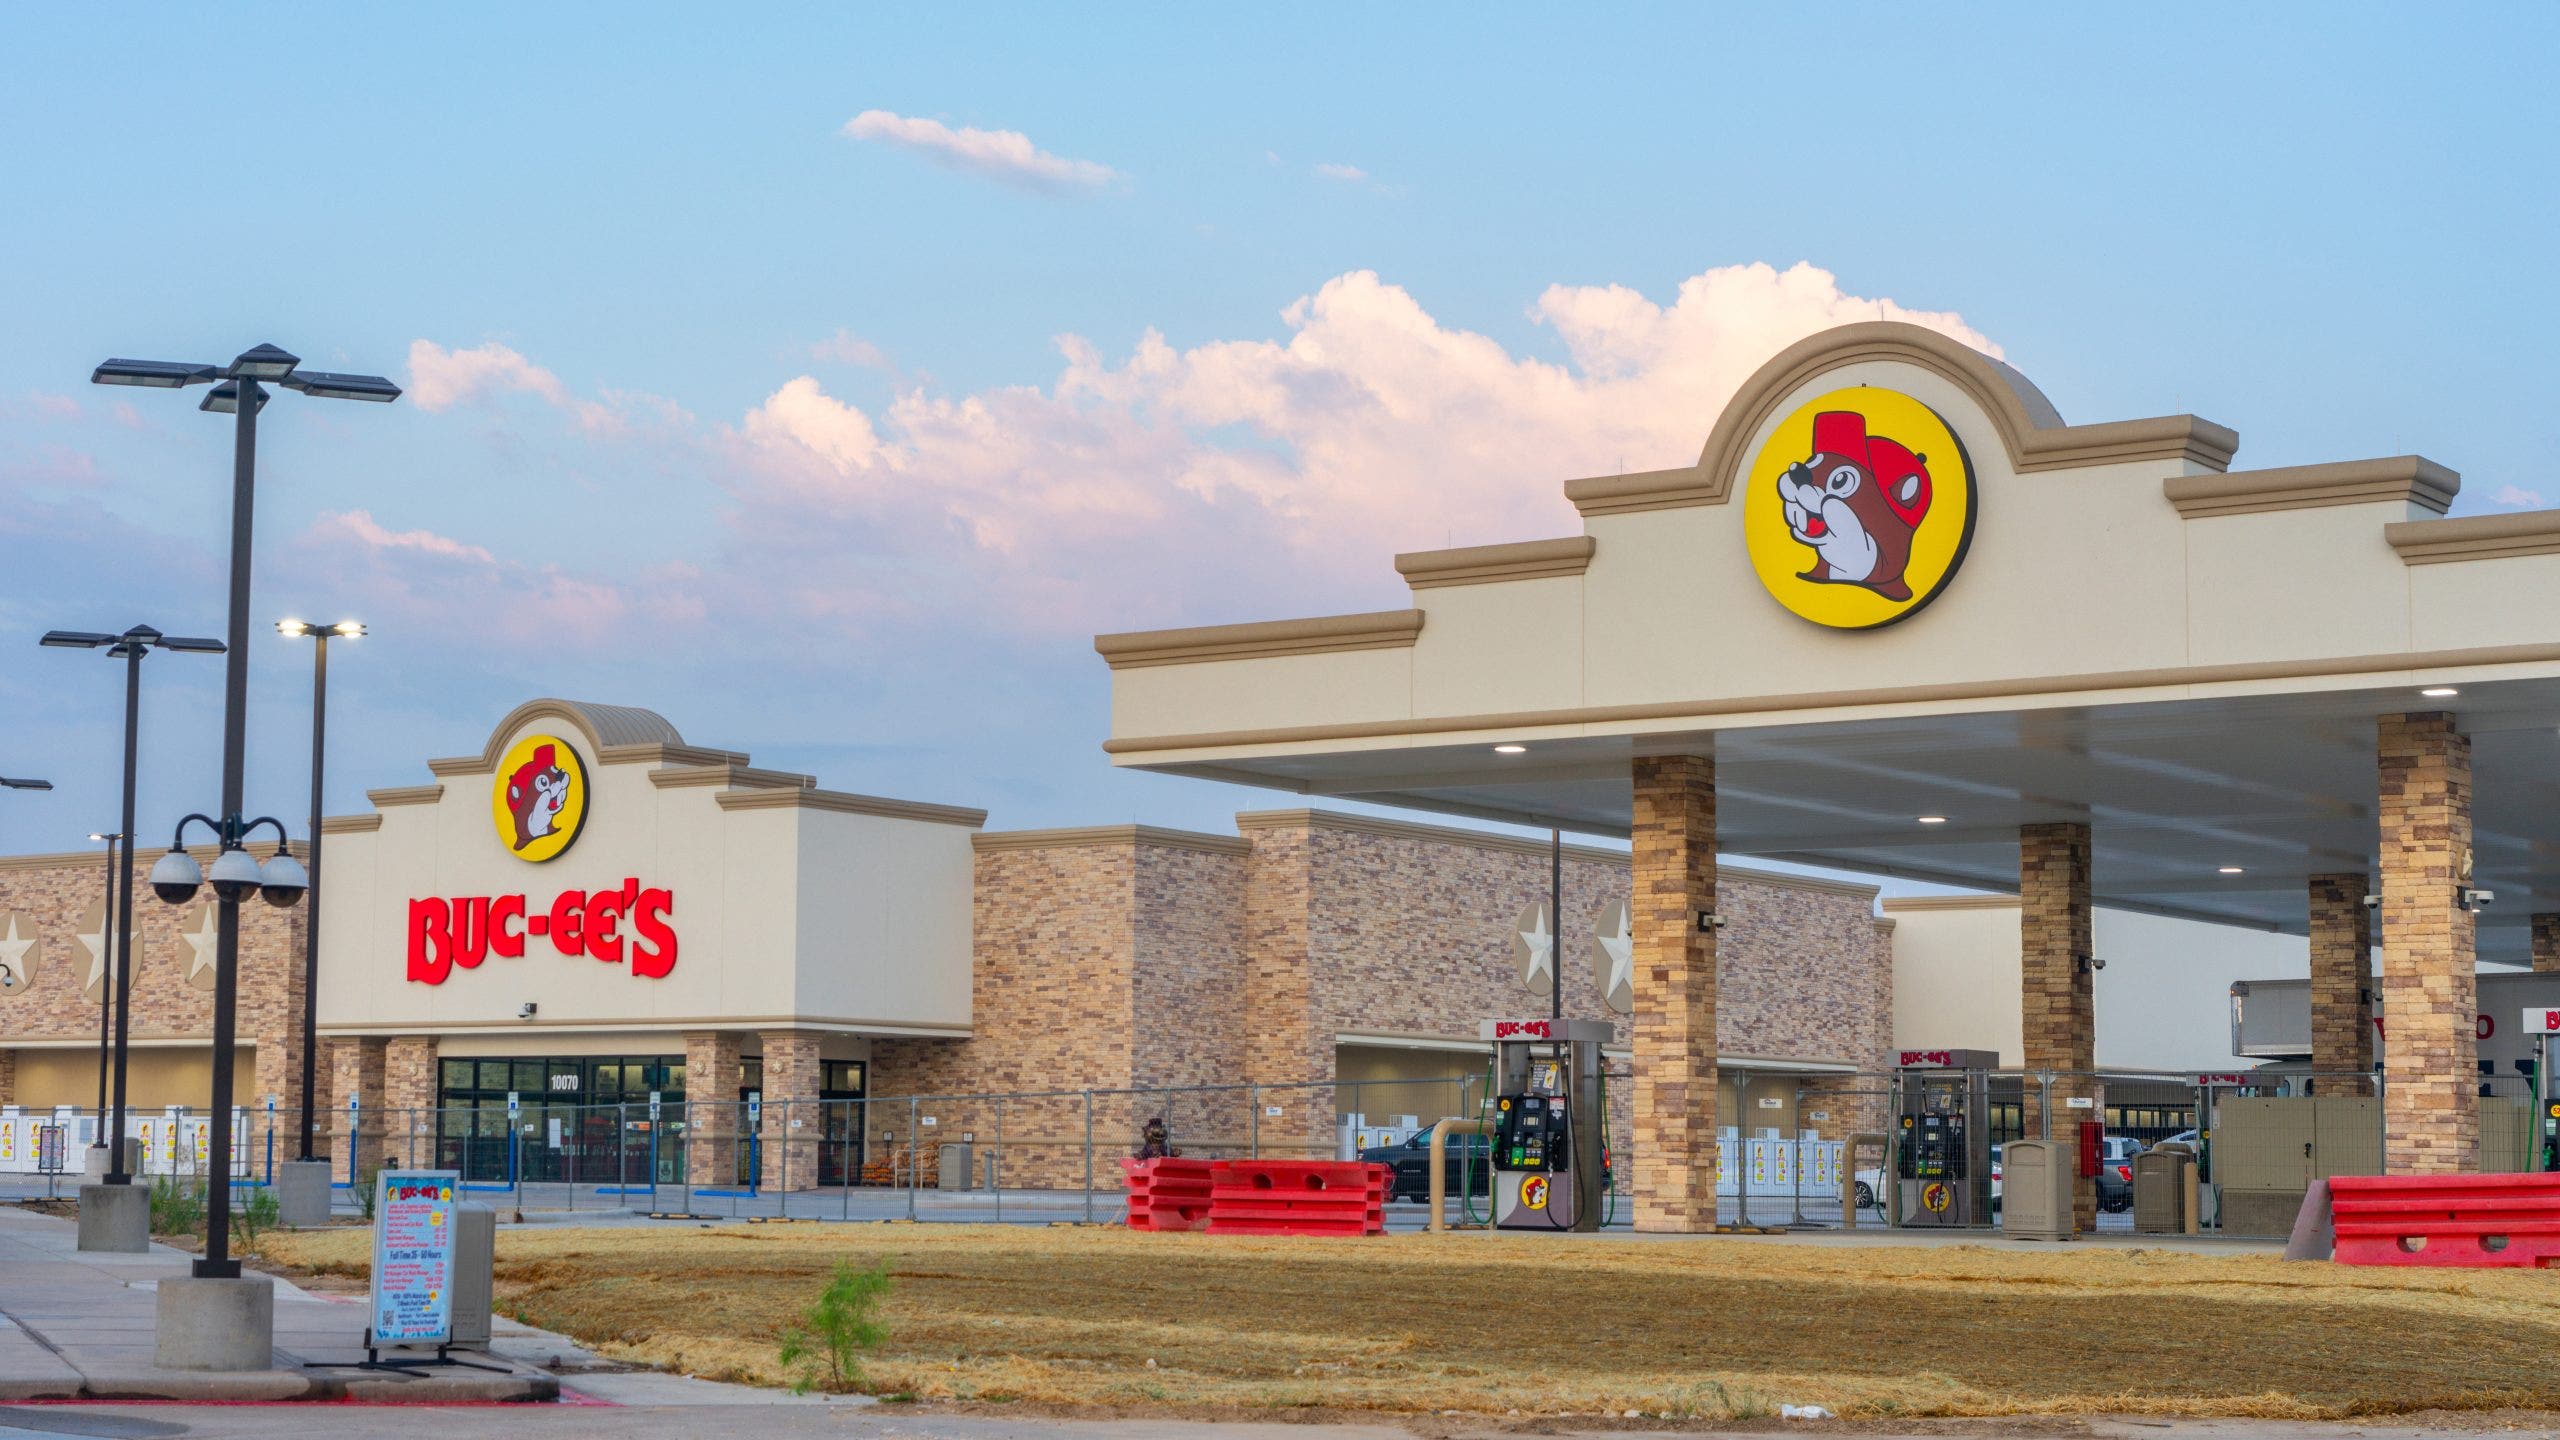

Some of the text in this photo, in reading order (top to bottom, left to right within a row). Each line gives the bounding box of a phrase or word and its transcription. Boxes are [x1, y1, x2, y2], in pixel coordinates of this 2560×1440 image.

[407, 878, 678, 985] BUC-EE'S
[1496, 1020, 1551, 1038] BUC-EE'S
[1900, 1051, 1951, 1066] BUC-EE'S
[551, 1074, 579, 1090] 10070
